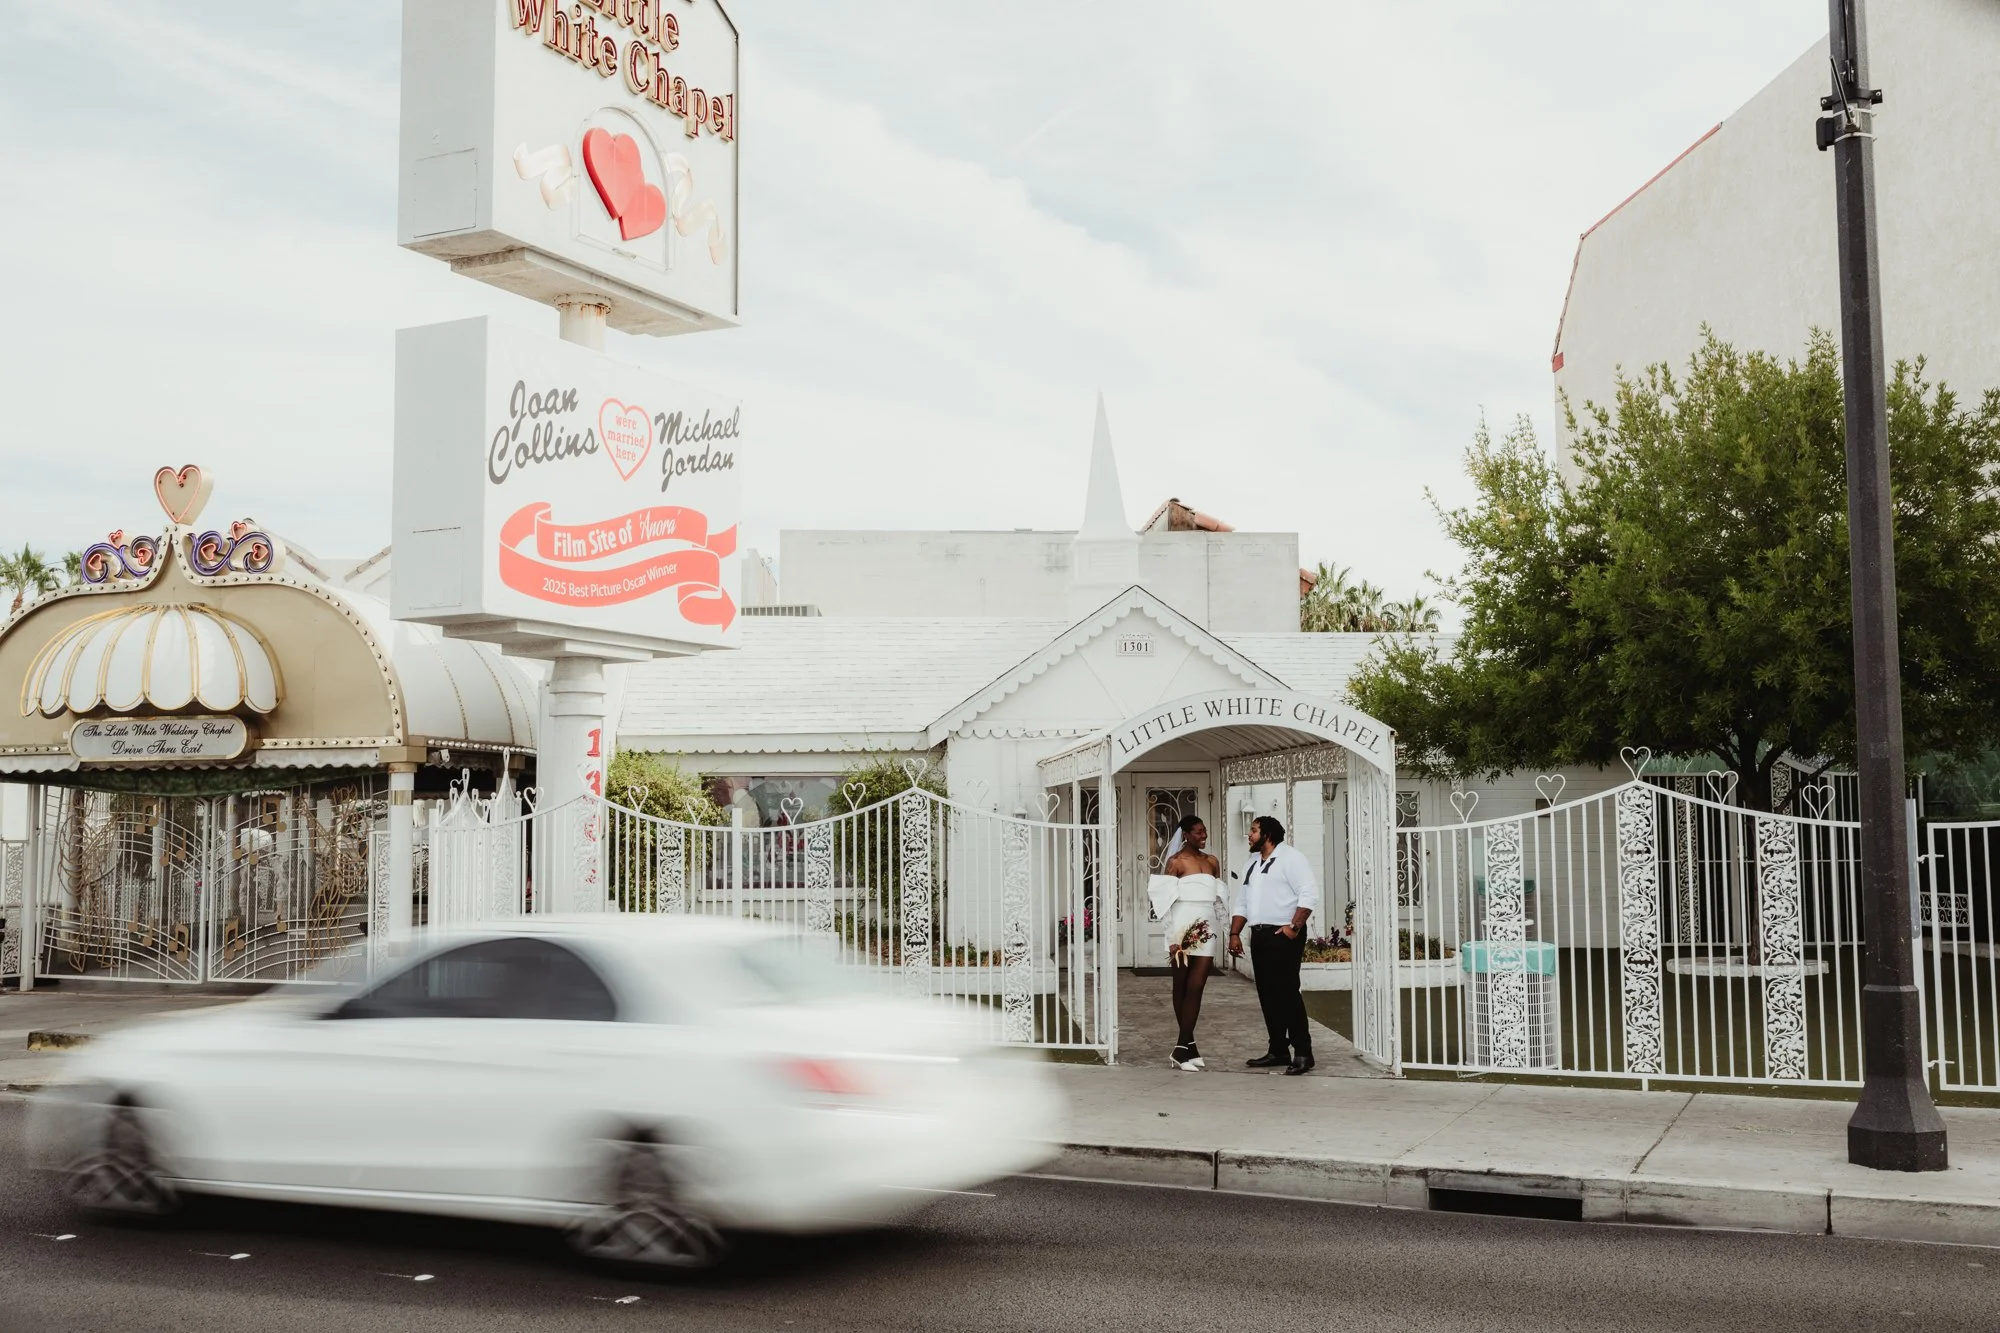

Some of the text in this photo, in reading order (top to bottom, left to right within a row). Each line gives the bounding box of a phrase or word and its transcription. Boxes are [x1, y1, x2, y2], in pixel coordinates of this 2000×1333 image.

[622, 40, 733, 141] Chapel
[510, 380, 579, 441] Joan
[616, 416, 637, 429] were
[655, 406, 739, 445] Michael
[489, 421, 599, 484] Collins
[608, 430, 644, 448] married
[616, 445, 636, 461] here
[662, 443, 734, 492] Jordan
[554, 531, 586, 557] Film
[588, 529, 617, 555] Site
[618, 519, 633, 545] of
[542, 564, 677, 598] 2025 Best Picture Oscar Winner
[1123, 642, 1148, 652] 1301
[83, 723, 235, 738] The Little White Wedding Chapel
[1117, 697, 1382, 755] LITTLE WHITE CHAPEL
[112, 739, 203, 755] Drive Thru Exit
